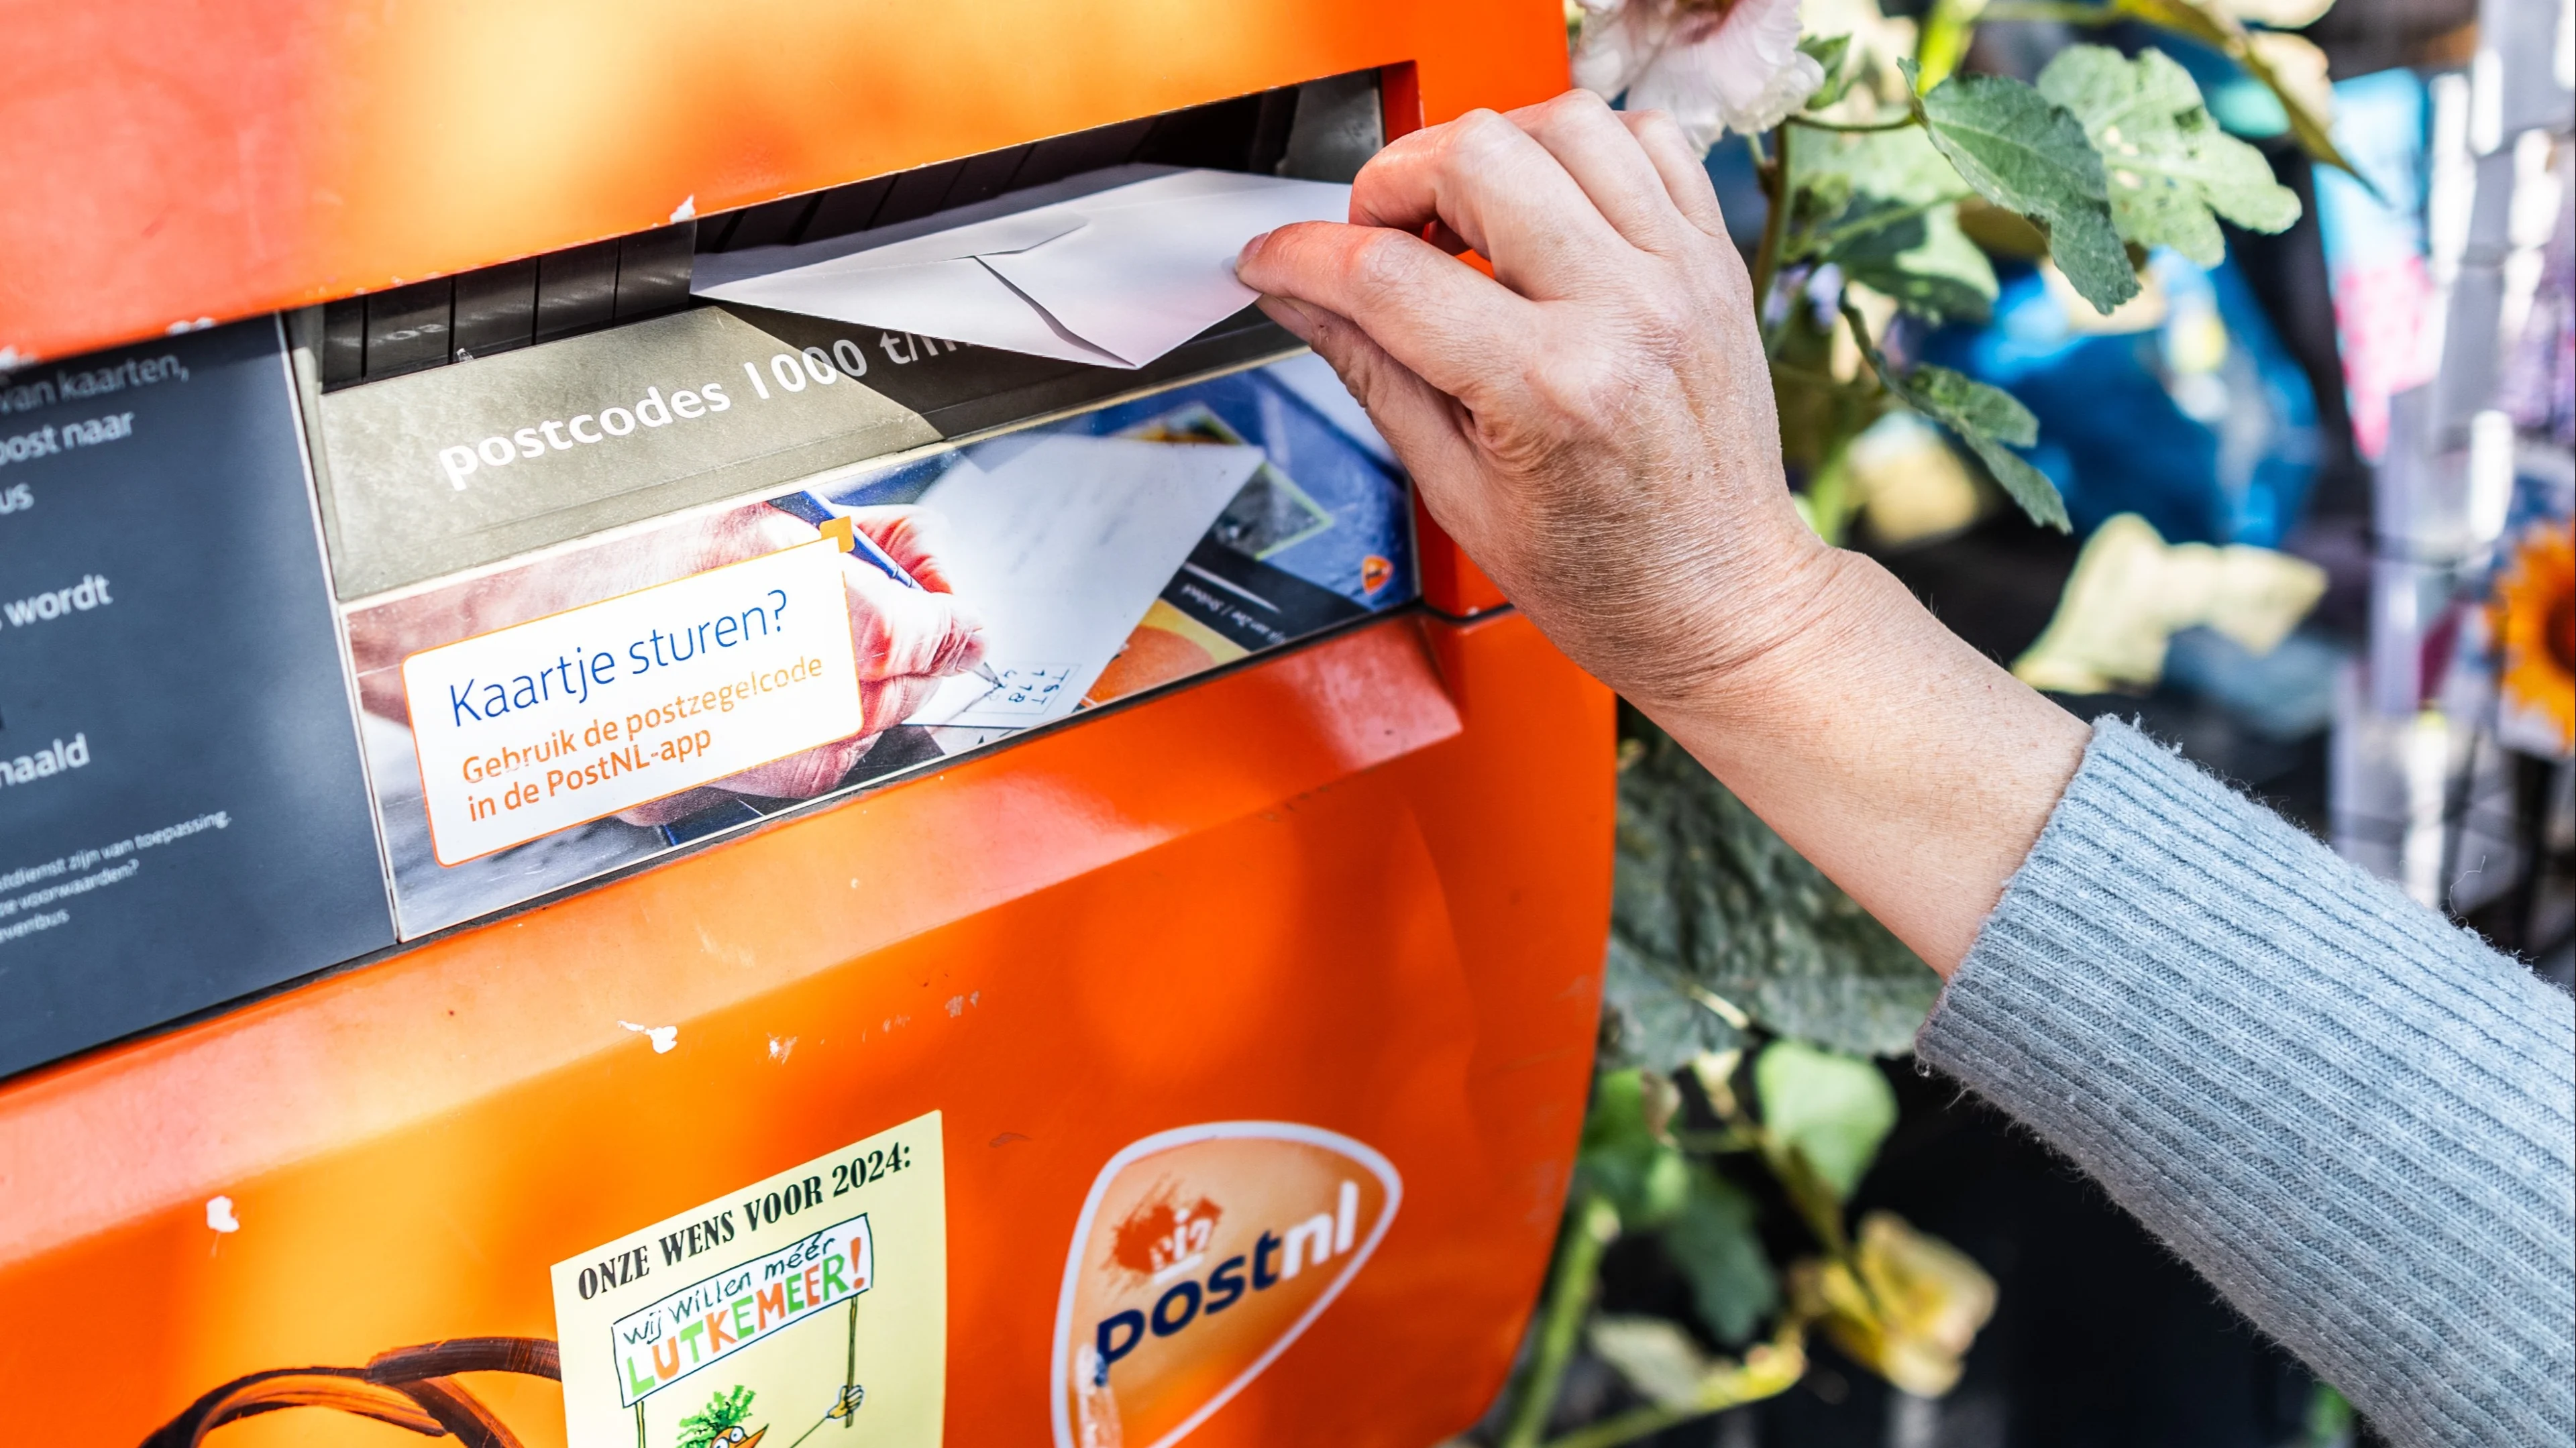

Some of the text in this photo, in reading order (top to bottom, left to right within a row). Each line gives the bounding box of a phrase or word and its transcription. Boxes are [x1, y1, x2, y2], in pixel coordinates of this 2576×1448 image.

[57, 354, 189, 399] kaarten,
[439, 382, 731, 491] postcodes
[744, 339, 867, 400] 1000
[62, 410, 134, 449] naar
[3, 574, 114, 626] wordt
[450, 589, 788, 728] Kaartje sturen?
[462, 655, 822, 783] Gebruik de postzegelcode
[468, 728, 712, 822] in de PostNL-app
[18, 858, 140, 910] voorwaarden?
[68, 848, 100, 871] zijn
[101, 839, 133, 859] van
[134, 811, 231, 850] toepassing.
[578, 1141, 911, 1300] ONZE WENS VOOR 2024:
[623, 1309, 663, 1345] wij
[626, 1237, 865, 1398] LUTKEMEER!
[1093, 1180, 1358, 1387] postnl
